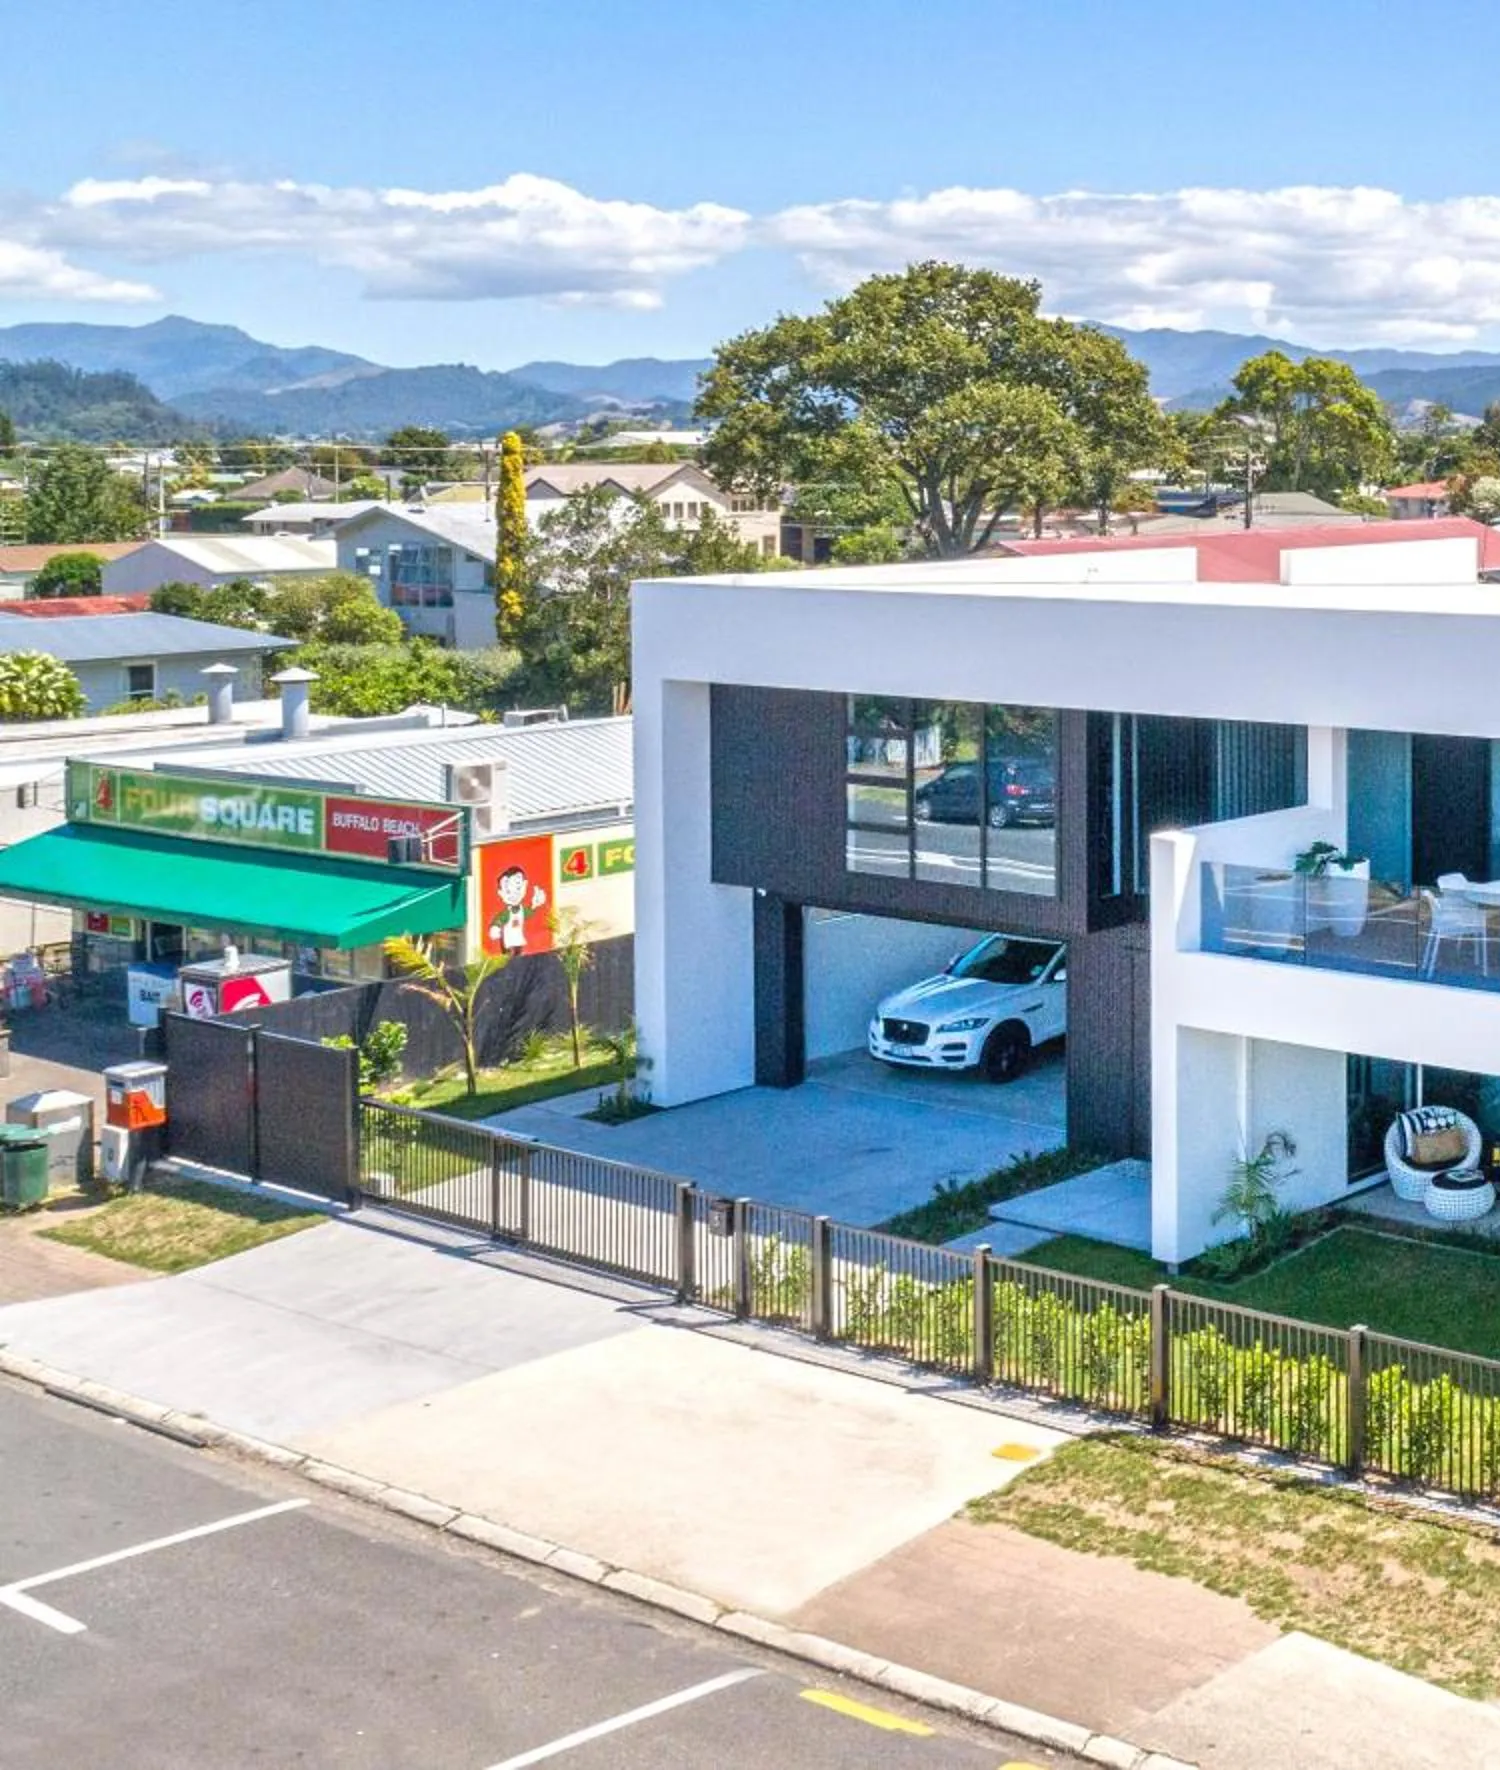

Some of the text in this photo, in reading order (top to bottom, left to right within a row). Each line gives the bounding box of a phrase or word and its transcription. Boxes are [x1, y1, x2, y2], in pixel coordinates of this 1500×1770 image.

[200, 795, 315, 835] SQUARE
[332, 811, 421, 838] BUFFALO BEACH
[564, 848, 590, 877] 4
